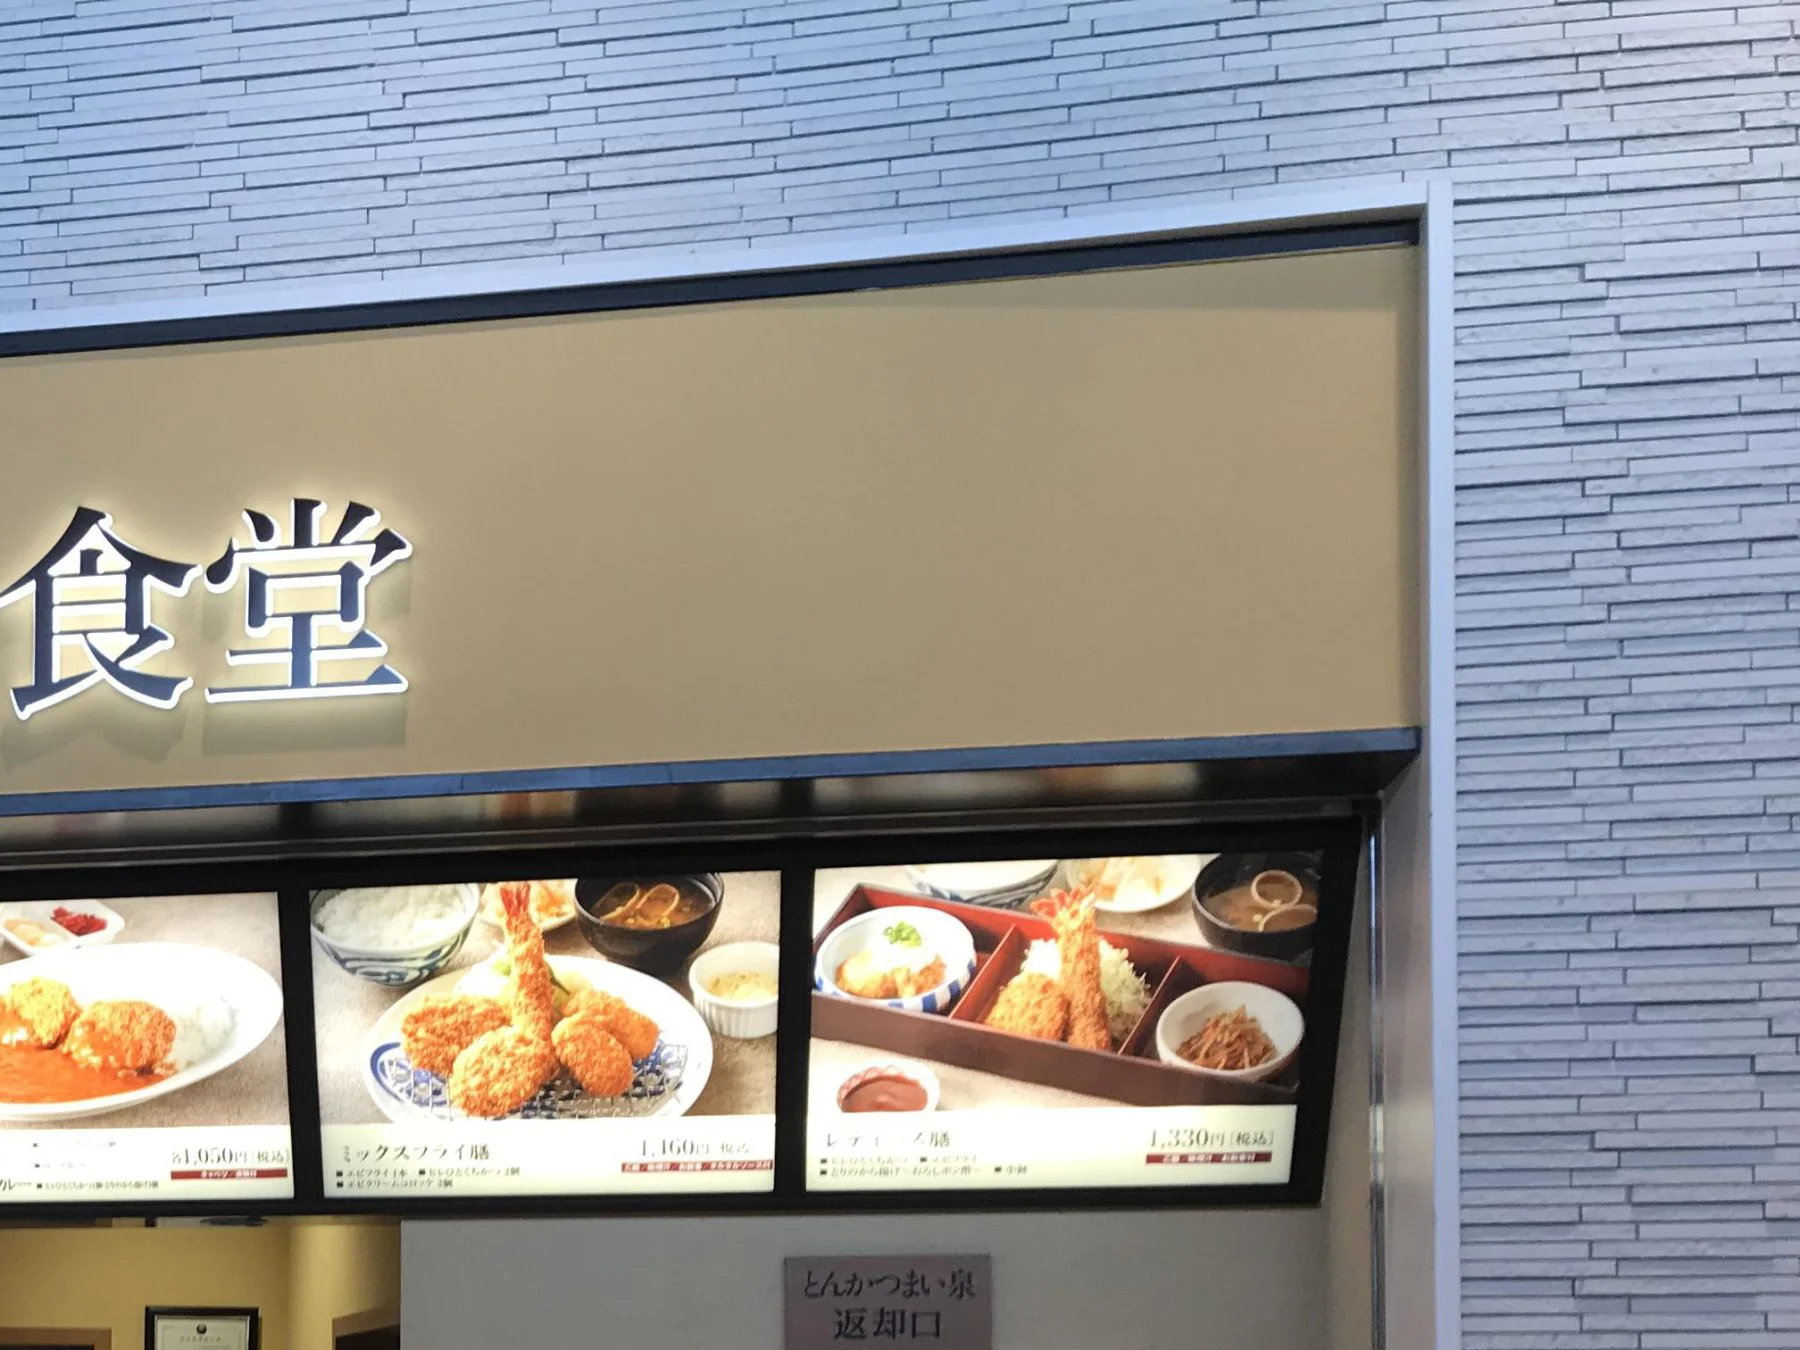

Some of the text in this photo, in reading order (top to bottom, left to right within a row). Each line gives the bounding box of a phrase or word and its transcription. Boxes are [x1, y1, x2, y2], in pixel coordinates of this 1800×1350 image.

[826, 1130, 950, 1149] レディス膳
[804, 1269, 976, 1300] とんかつまい泉
[834, 1307, 942, 1340] 返却口
